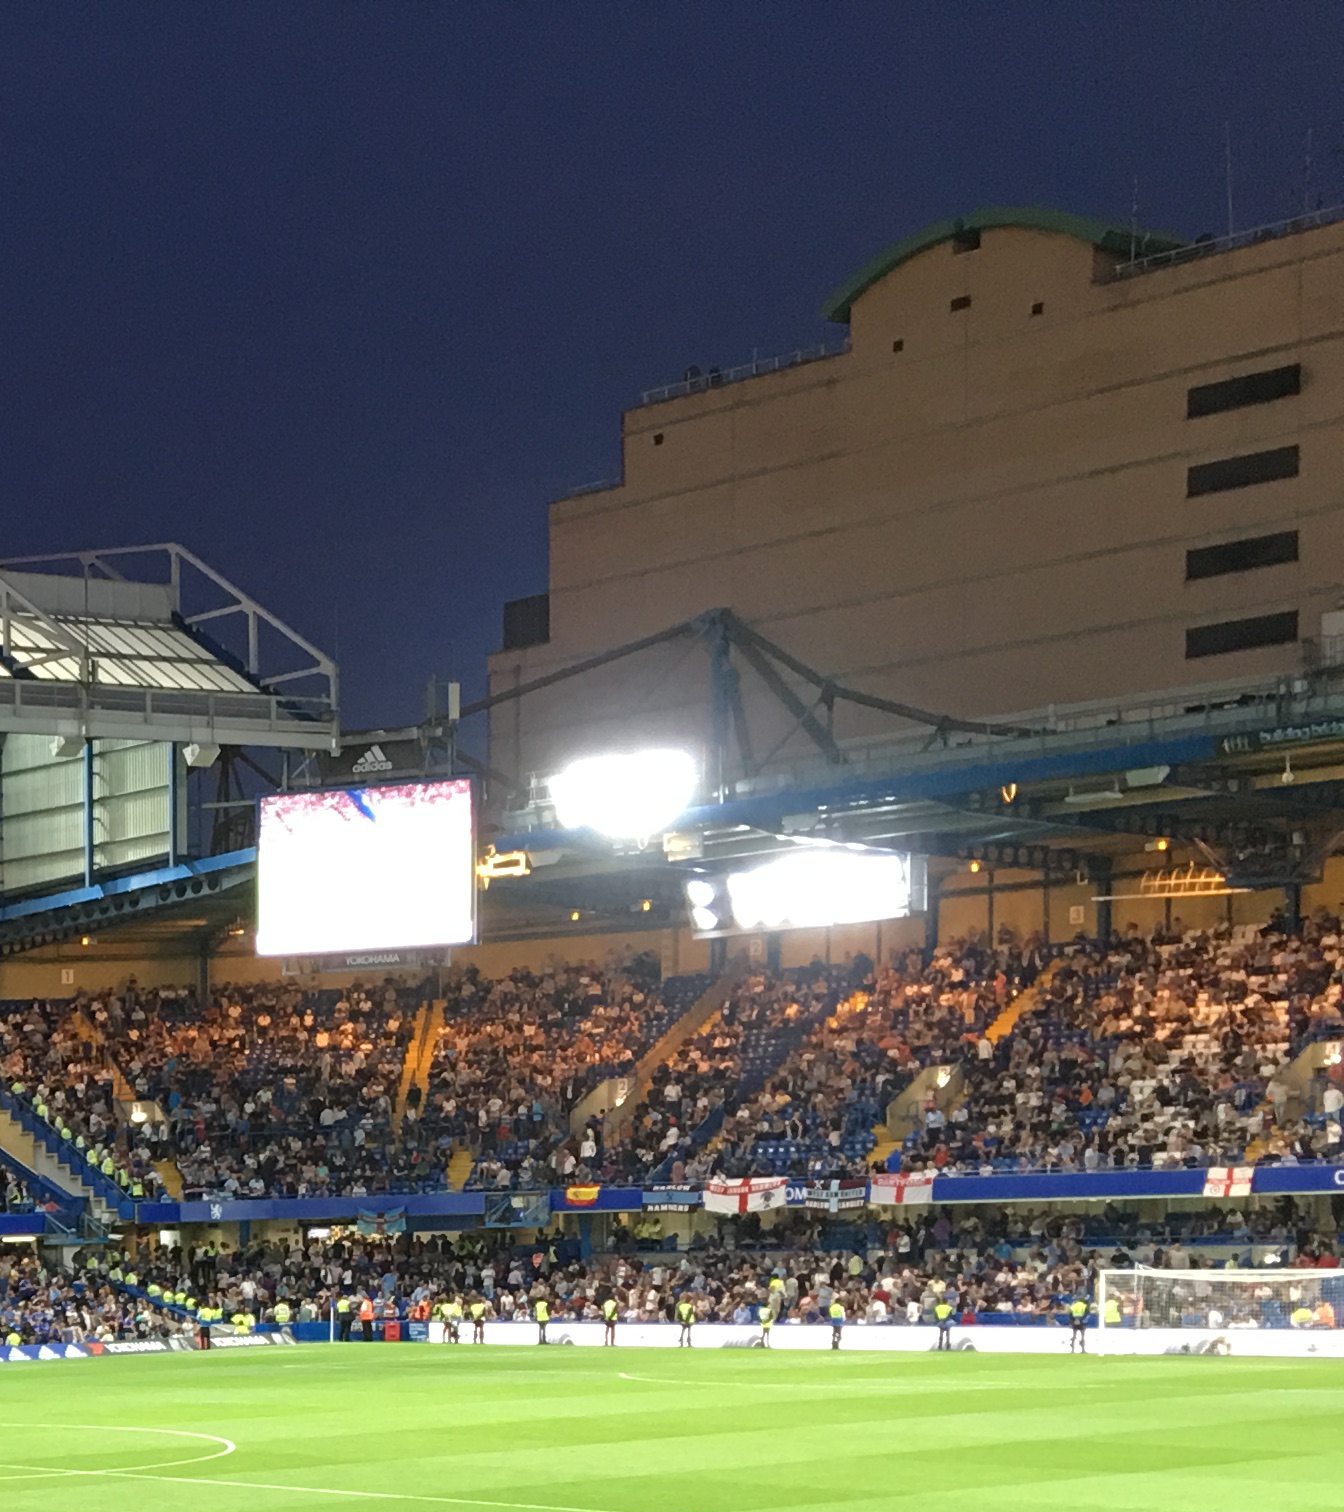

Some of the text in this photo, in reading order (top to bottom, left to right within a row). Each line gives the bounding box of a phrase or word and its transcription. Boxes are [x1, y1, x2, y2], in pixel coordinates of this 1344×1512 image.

[352, 759, 392, 773] adidas
[345, 953, 400, 966] YOKOHAMA
[104, 1341, 167, 1353] YOKOHAMA
